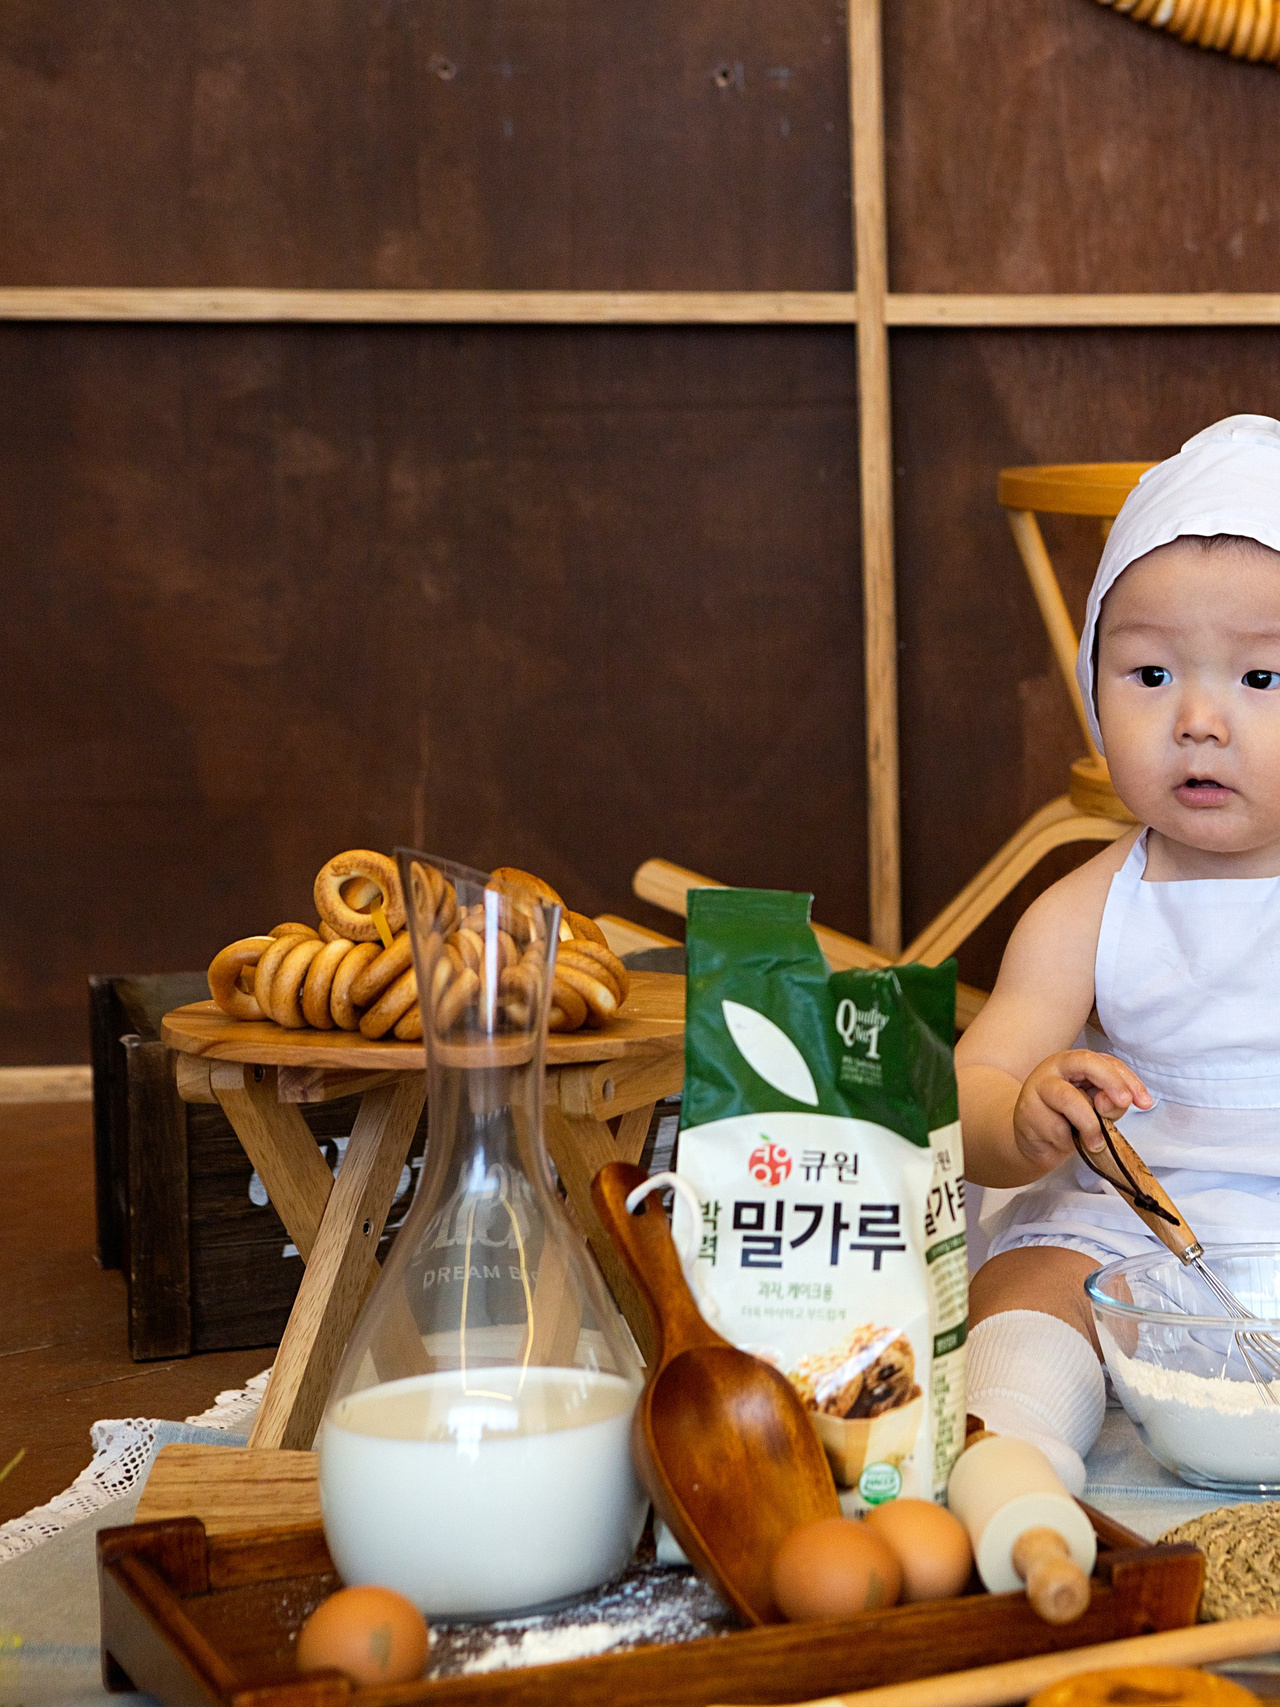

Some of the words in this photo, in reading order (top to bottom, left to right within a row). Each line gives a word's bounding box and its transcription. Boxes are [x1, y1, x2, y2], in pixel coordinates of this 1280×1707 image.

[800, 1150, 858, 1184] 큐원
[732, 1199, 906, 1271] 밀가루
[422, 1264, 501, 1290] DREAM
